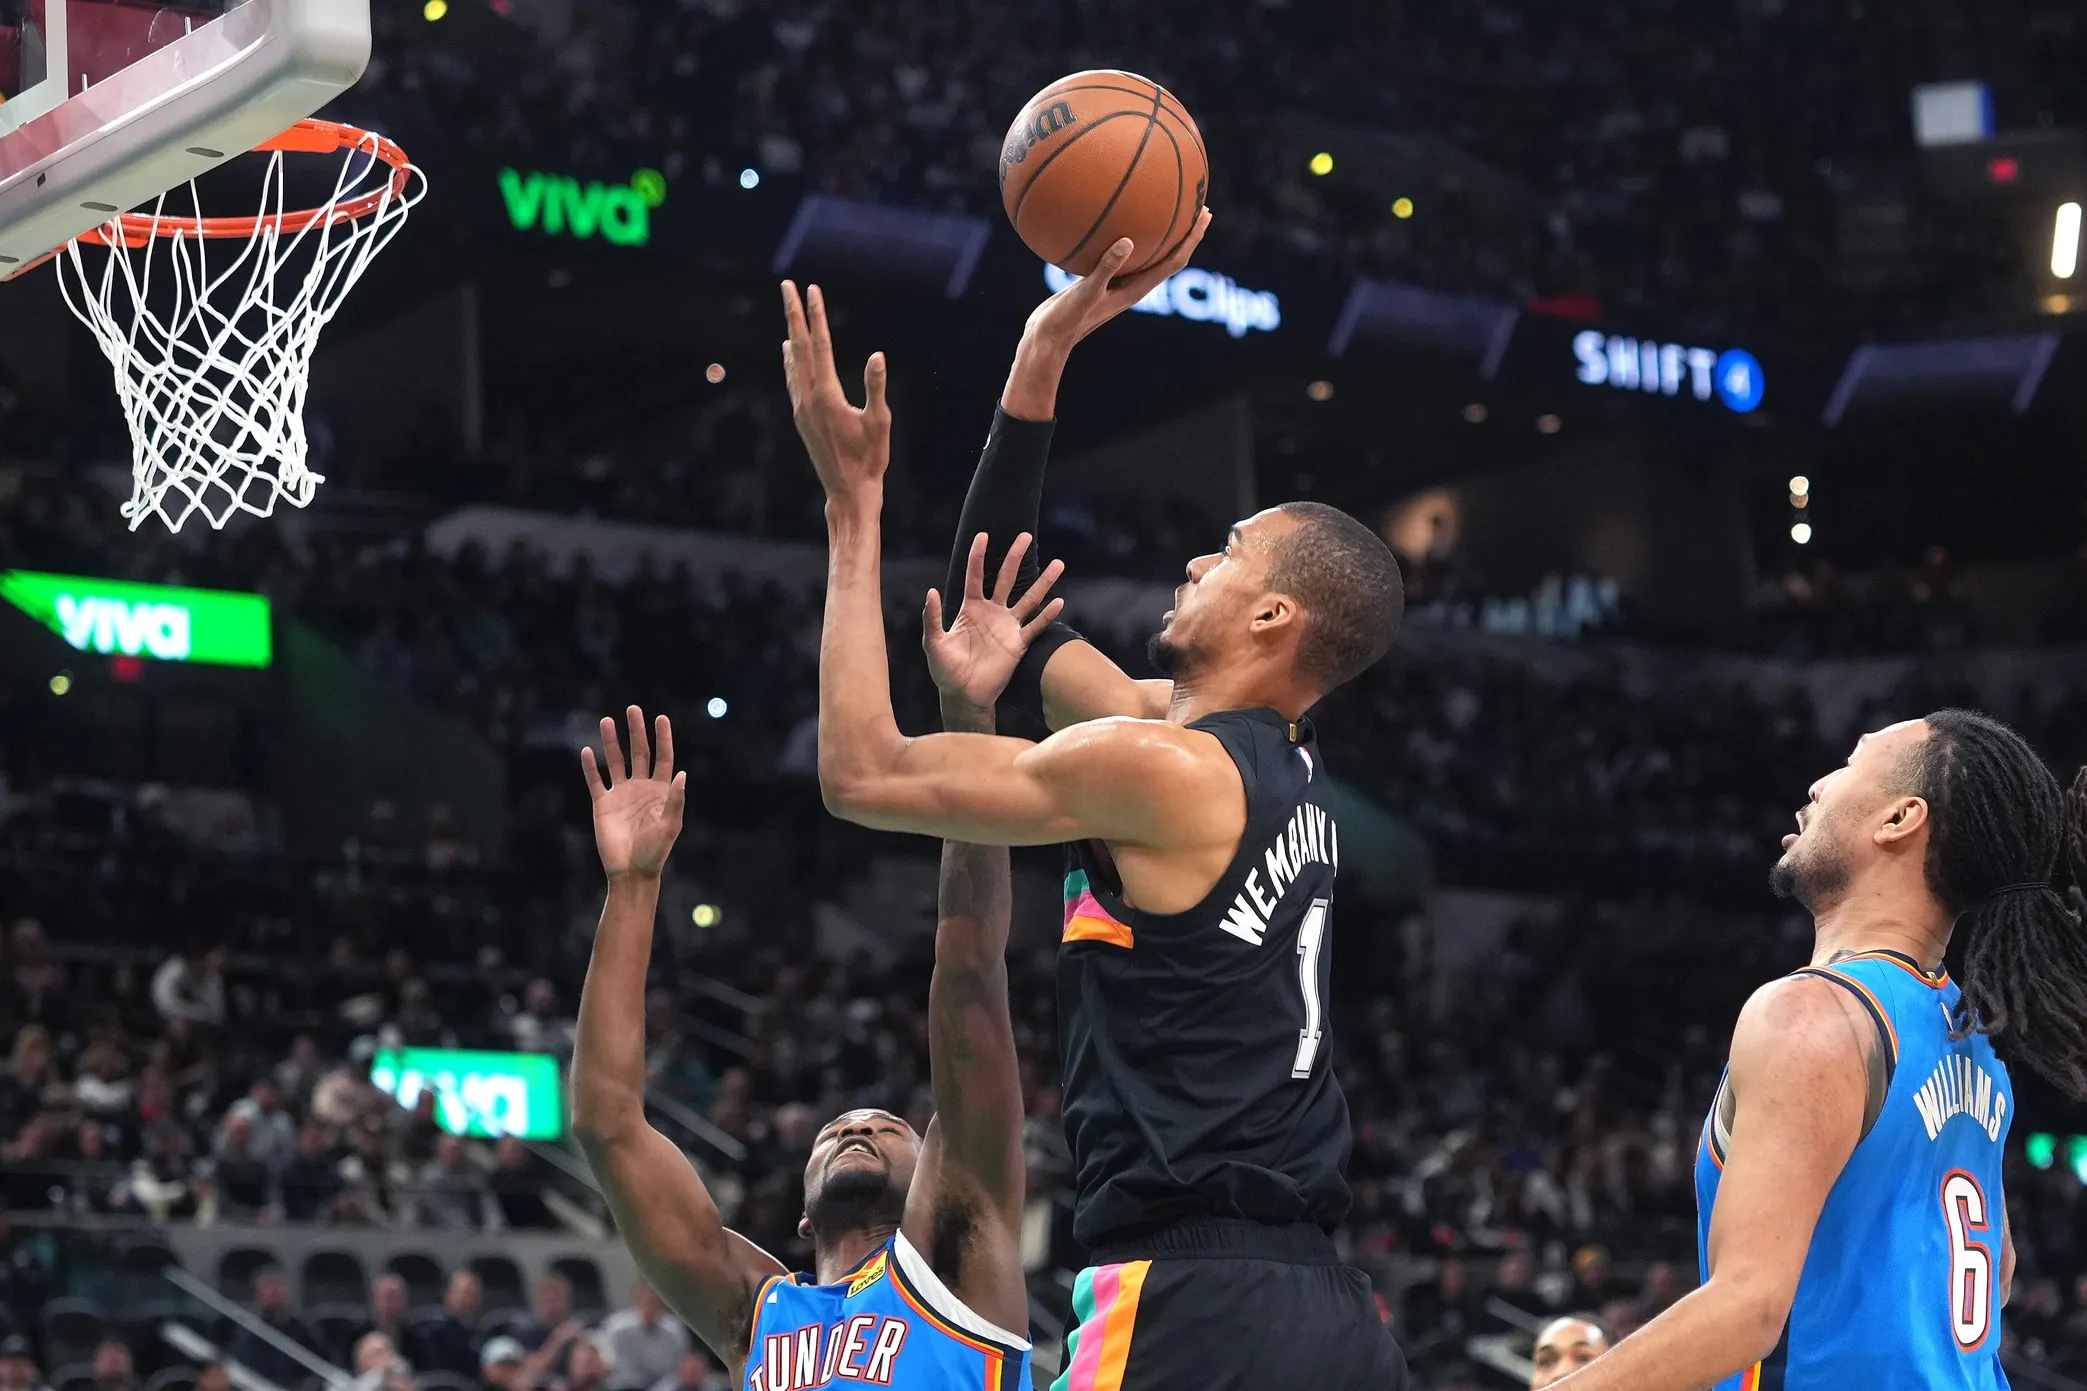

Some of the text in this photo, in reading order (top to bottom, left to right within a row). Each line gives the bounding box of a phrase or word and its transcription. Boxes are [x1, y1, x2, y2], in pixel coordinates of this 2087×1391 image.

[498, 166, 650, 248] viva
[55, 593, 190, 659] viva
[1291, 897, 1328, 1080] 1
[1912, 1054, 2006, 1142] WILLIAMS
[1940, 1167, 1992, 1353] 6
